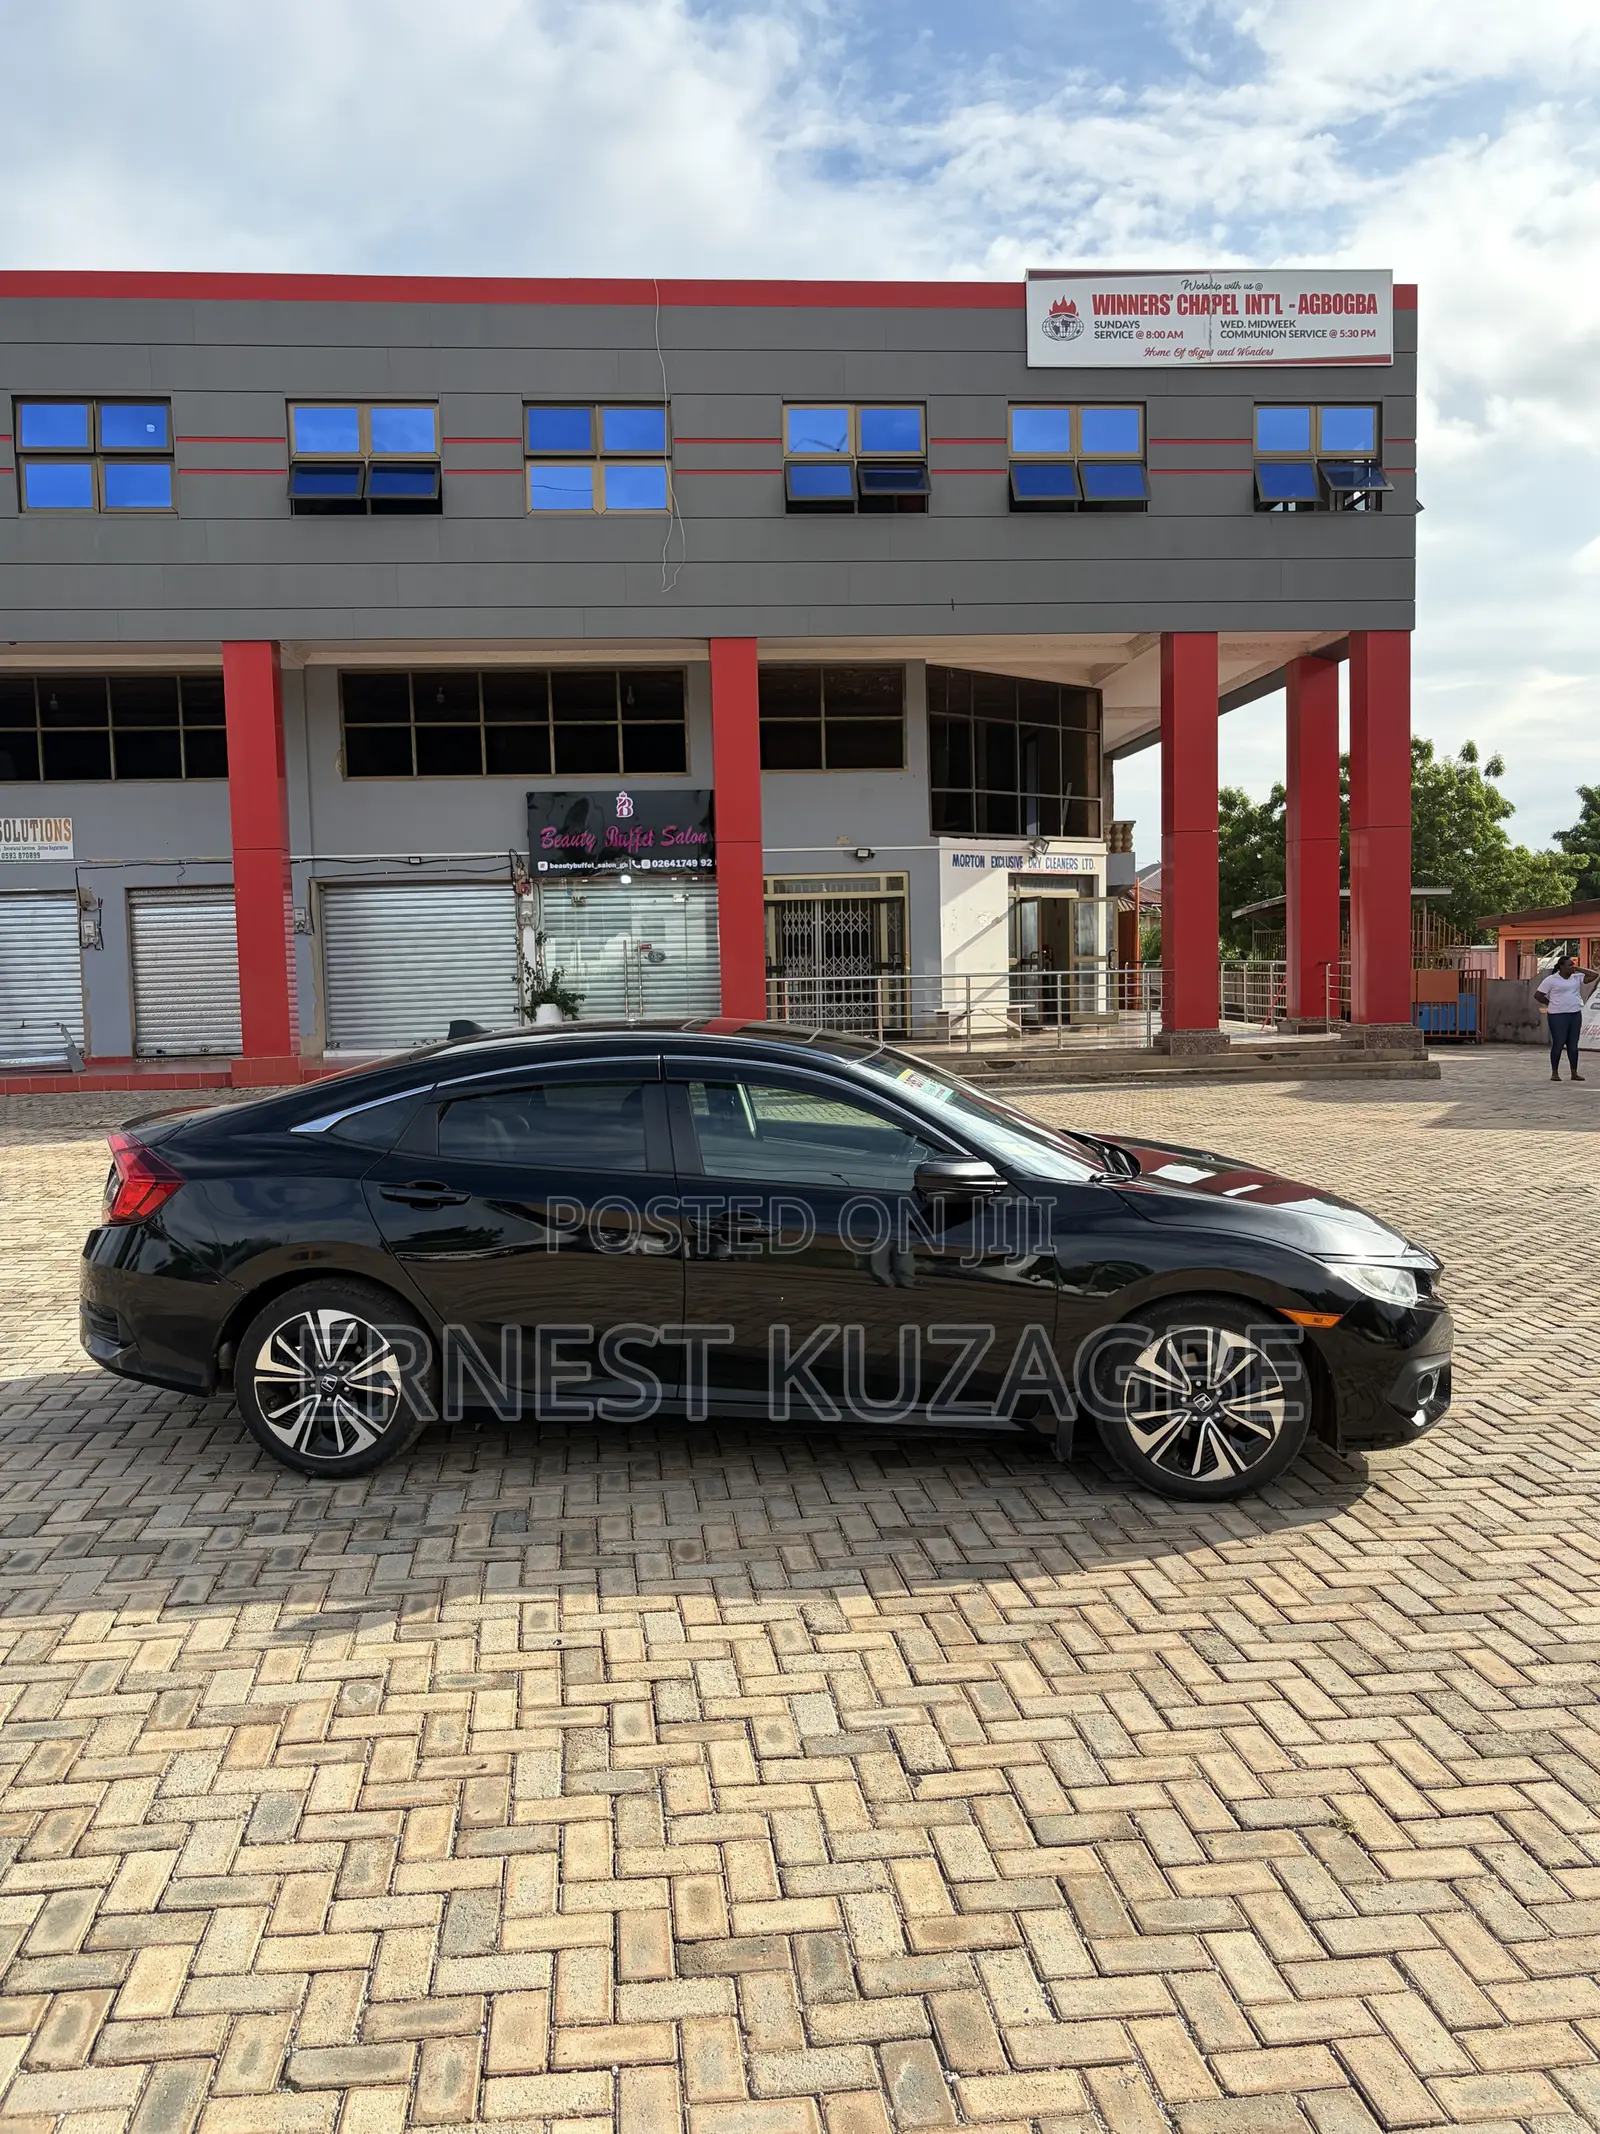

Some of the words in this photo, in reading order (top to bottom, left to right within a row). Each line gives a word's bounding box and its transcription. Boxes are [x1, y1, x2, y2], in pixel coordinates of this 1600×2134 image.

[1181, 279, 1221, 291] Worship
[1224, 281, 1241, 290] with
[1255, 282, 1264, 291] @
[1092, 294, 1173, 315] WINNERS'
[1177, 293, 1239, 315] CHAPEL
[1245, 293, 1283, 315] INT'L
[1298, 293, 1378, 315] AGBOGBA
[1094, 320, 1140, 329] SUNDAYS
[1220, 320, 1246, 329] WED.
[1248, 320, 1296, 329] MIDWEEK
[1094, 330, 1134, 339] SERVICE
[1135, 330, 1145, 339] @
[1146, 330, 1166, 339] 8:00
[1167, 330, 1184, 339] AM
[1220, 330, 1287, 339] COMMUNION
[1288, 330, 1327, 339] SERVICE
[1329, 330, 1338, 339] @
[1339, 329, 1359, 338] 5:30
[1361, 329, 1376, 338] PM
[1143, 347, 1171, 357] Home
[1174, 347, 1186, 359] Of
[1188, 347, 1213, 360] Signs
[1217, 347, 1235, 357] and
[1237, 346, 1274, 357] Wonders
[540, 826, 597, 854] Beauty
[605, 825, 655, 854] Buffet
[660, 824, 708, 847] Salon
[700, 859, 713, 867] 92
[952, 854, 985, 868] MORTON
[991, 855, 1023, 868] EXCLUSIVE
[1028, 856, 1042, 869] DRY
[1045, 857, 1078, 870] CLEANERS
[1082, 858, 1095, 870] LTD.
